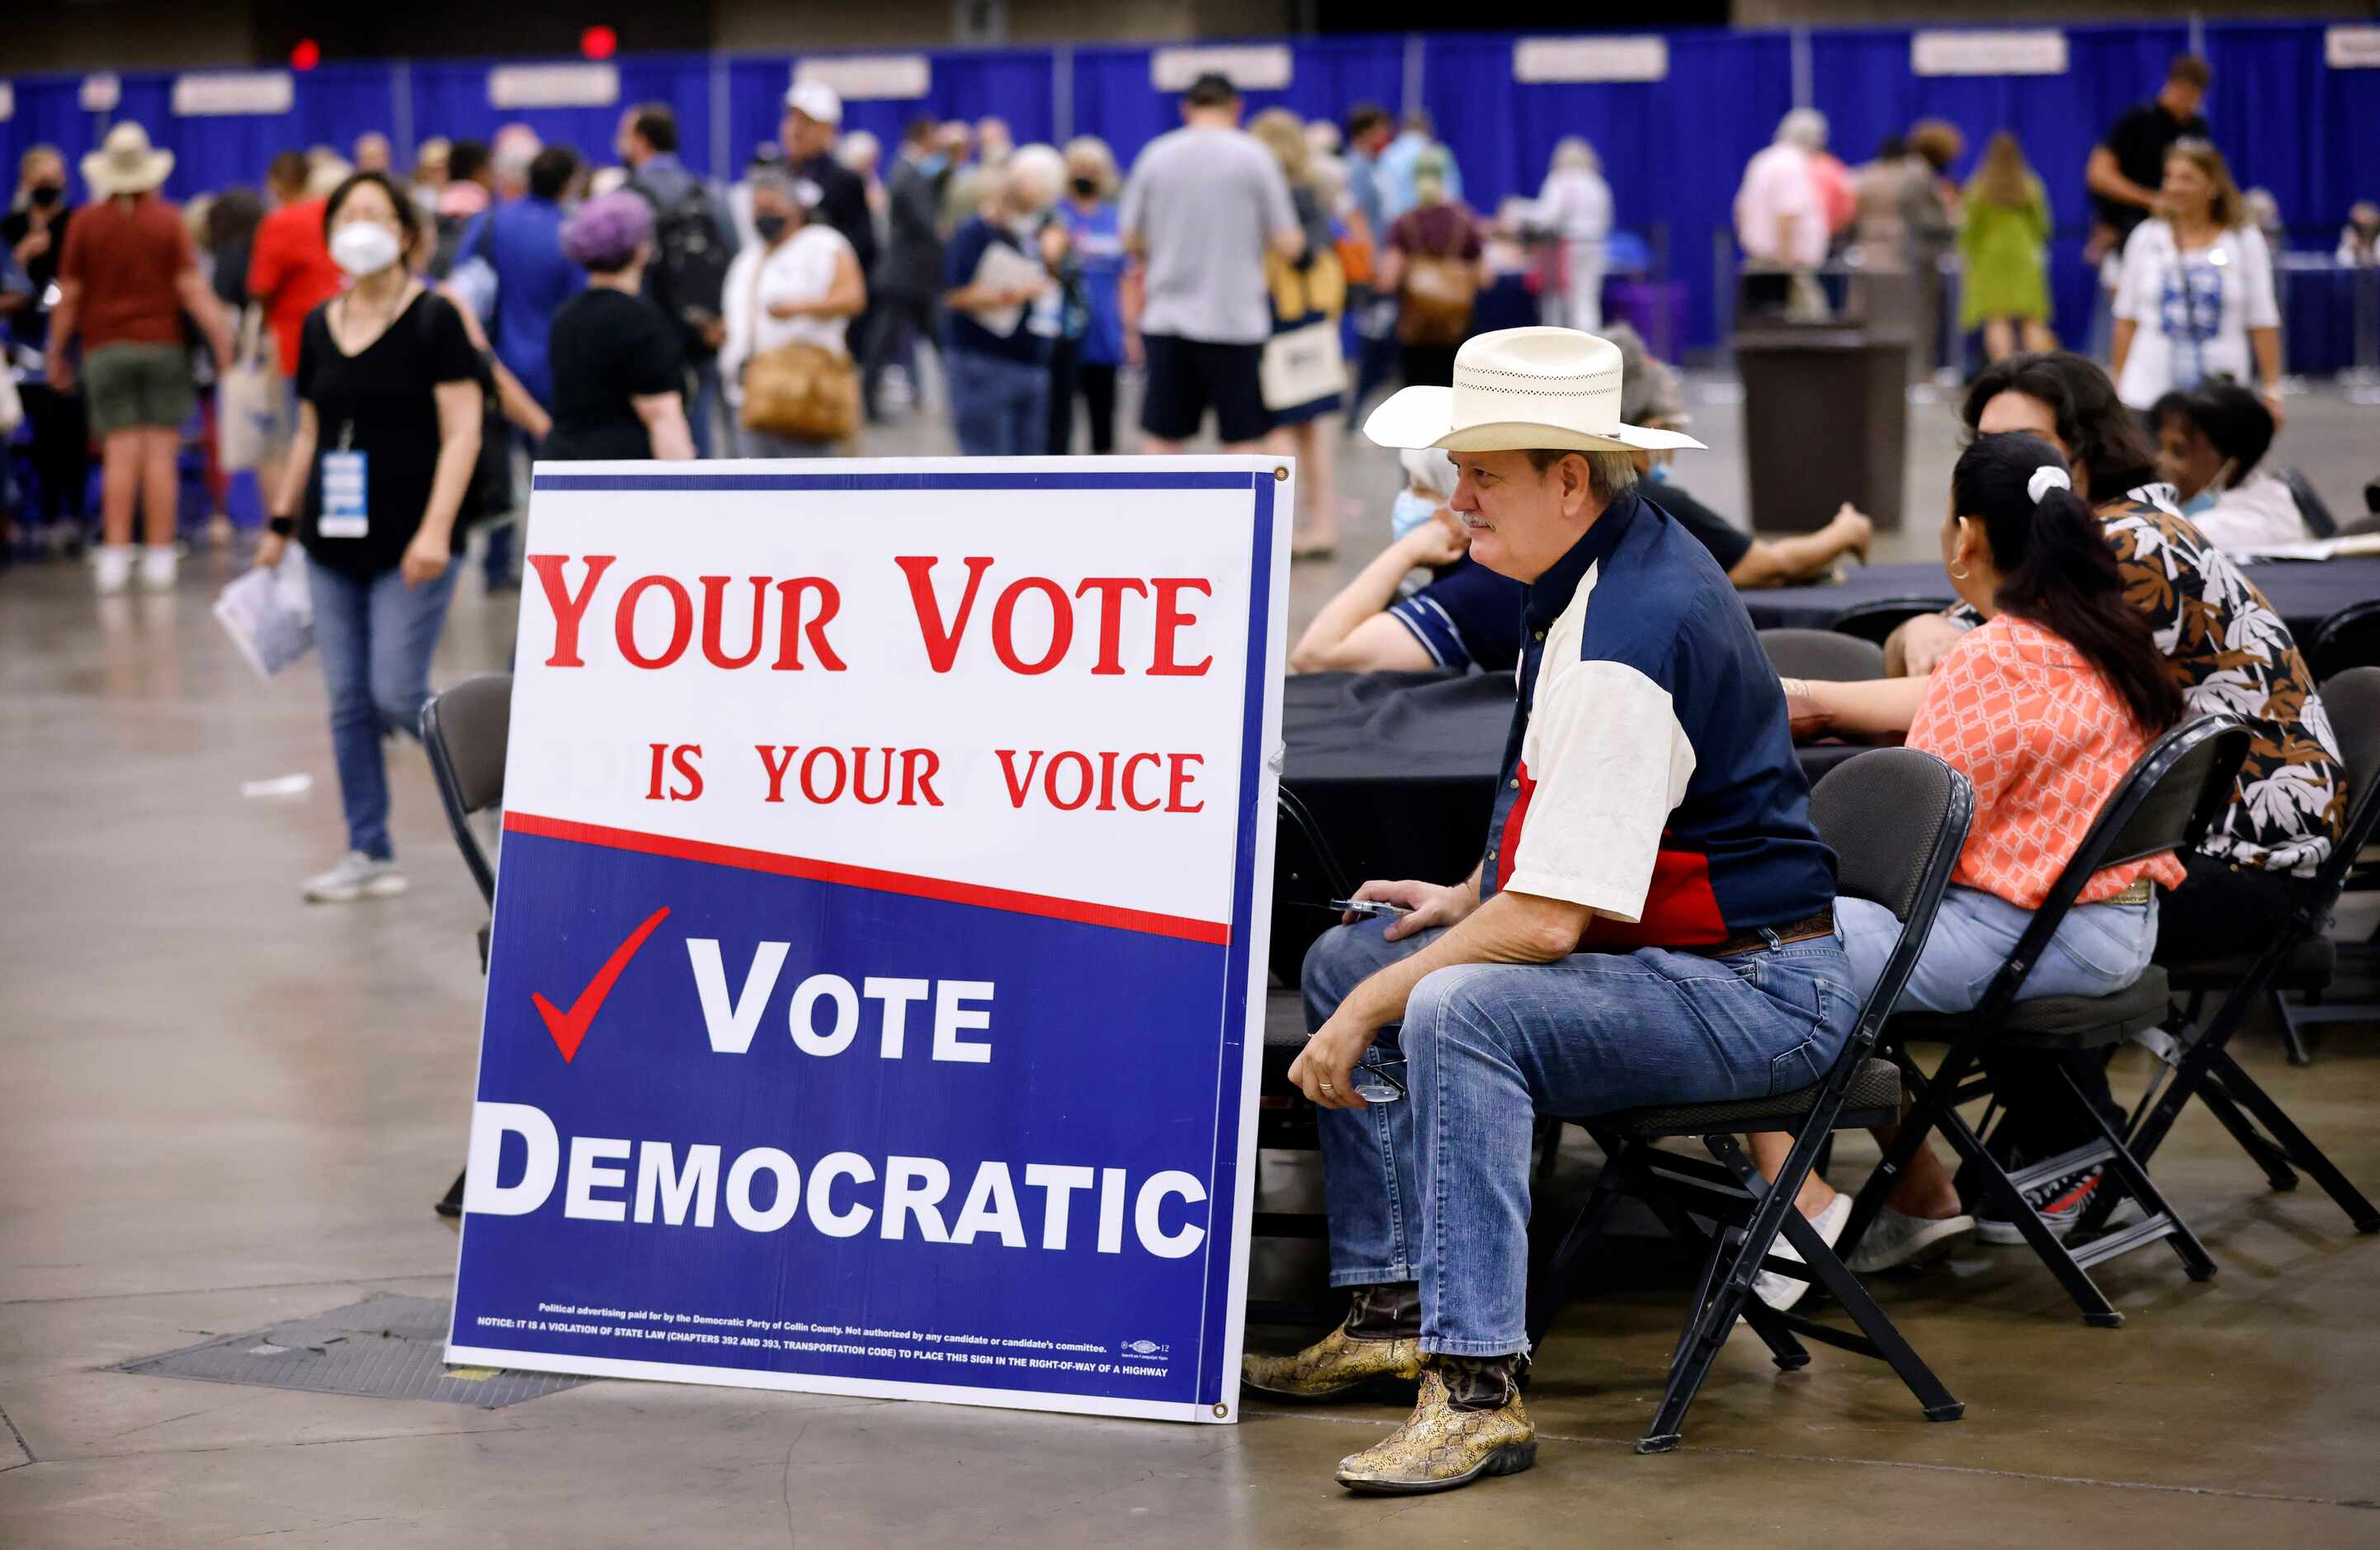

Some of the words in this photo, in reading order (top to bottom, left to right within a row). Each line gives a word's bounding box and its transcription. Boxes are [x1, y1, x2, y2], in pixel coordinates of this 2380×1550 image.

[528, 555, 848, 672] YOUR
[894, 556, 1213, 676] VOTE
[646, 743, 704, 802] IS
[755, 744, 945, 806] YOUR
[994, 749, 1205, 814] VOICE
[687, 938, 994, 1062] VOTE
[464, 1101, 1207, 1259] DEMOCRATIC
[477, 1316, 516, 1328] NOTICE:
[516, 1320, 527, 1329] IT
[527, 1320, 538, 1330] IS
[539, 1321, 547, 1330] A
[548, 1322, 598, 1335] VIOLATION
[599, 1326, 613, 1335] OF
[614, 1327, 644, 1338] STATE
[645, 1330, 666, 1340] LAW
[667, 1331, 720, 1344] (CHAPTERS
[721, 1335, 739, 1345] 392
[739, 1337, 761, 1347] AND
[762, 1339, 782, 1350] 393,
[783, 1340, 866, 1355] TRANSPORTATION
[867, 1346, 897, 1359] CODE)
[898, 1349, 912, 1359] TO
[913, 1350, 944, 1361] PLACE
[946, 1352, 969, 1363] THIS
[970, 1354, 994, 1364] SIGN
[995, 1356, 1006, 1366] IN
[1008, 1357, 1027, 1367] THE
[1028, 1359, 1097, 1372] RIGHT-OF-WAY
[1098, 1363, 1112, 1373] OF
[1112, 1364, 1121, 1374] A
[1122, 1365, 1169, 1378] HIGHWAY
[538, 1302, 576, 1315] Political
[576, 1306, 626, 1320] advertising
[627, 1310, 648, 1321] paid
[649, 1311, 663, 1321] for
[663, 1312, 675, 1324] by
[676, 1313, 692, 1323] the
[692, 1314, 744, 1327] Democratic
[746, 1318, 771, 1330] Party
[772, 1321, 782, 1330] of
[783, 1321, 810, 1332] Collin
[810, 1323, 843, 1336] County.
[844, 1326, 862, 1335] Not
[862, 1328, 911, 1340] authorized
[912, 1330, 924, 1342] by
[924, 1333, 942, 1344] any
[943, 1335, 989, 1344] candidate
[1002, 1338, 1054, 1349] candidate's
[1055, 1343, 1107, 1354] committee.
